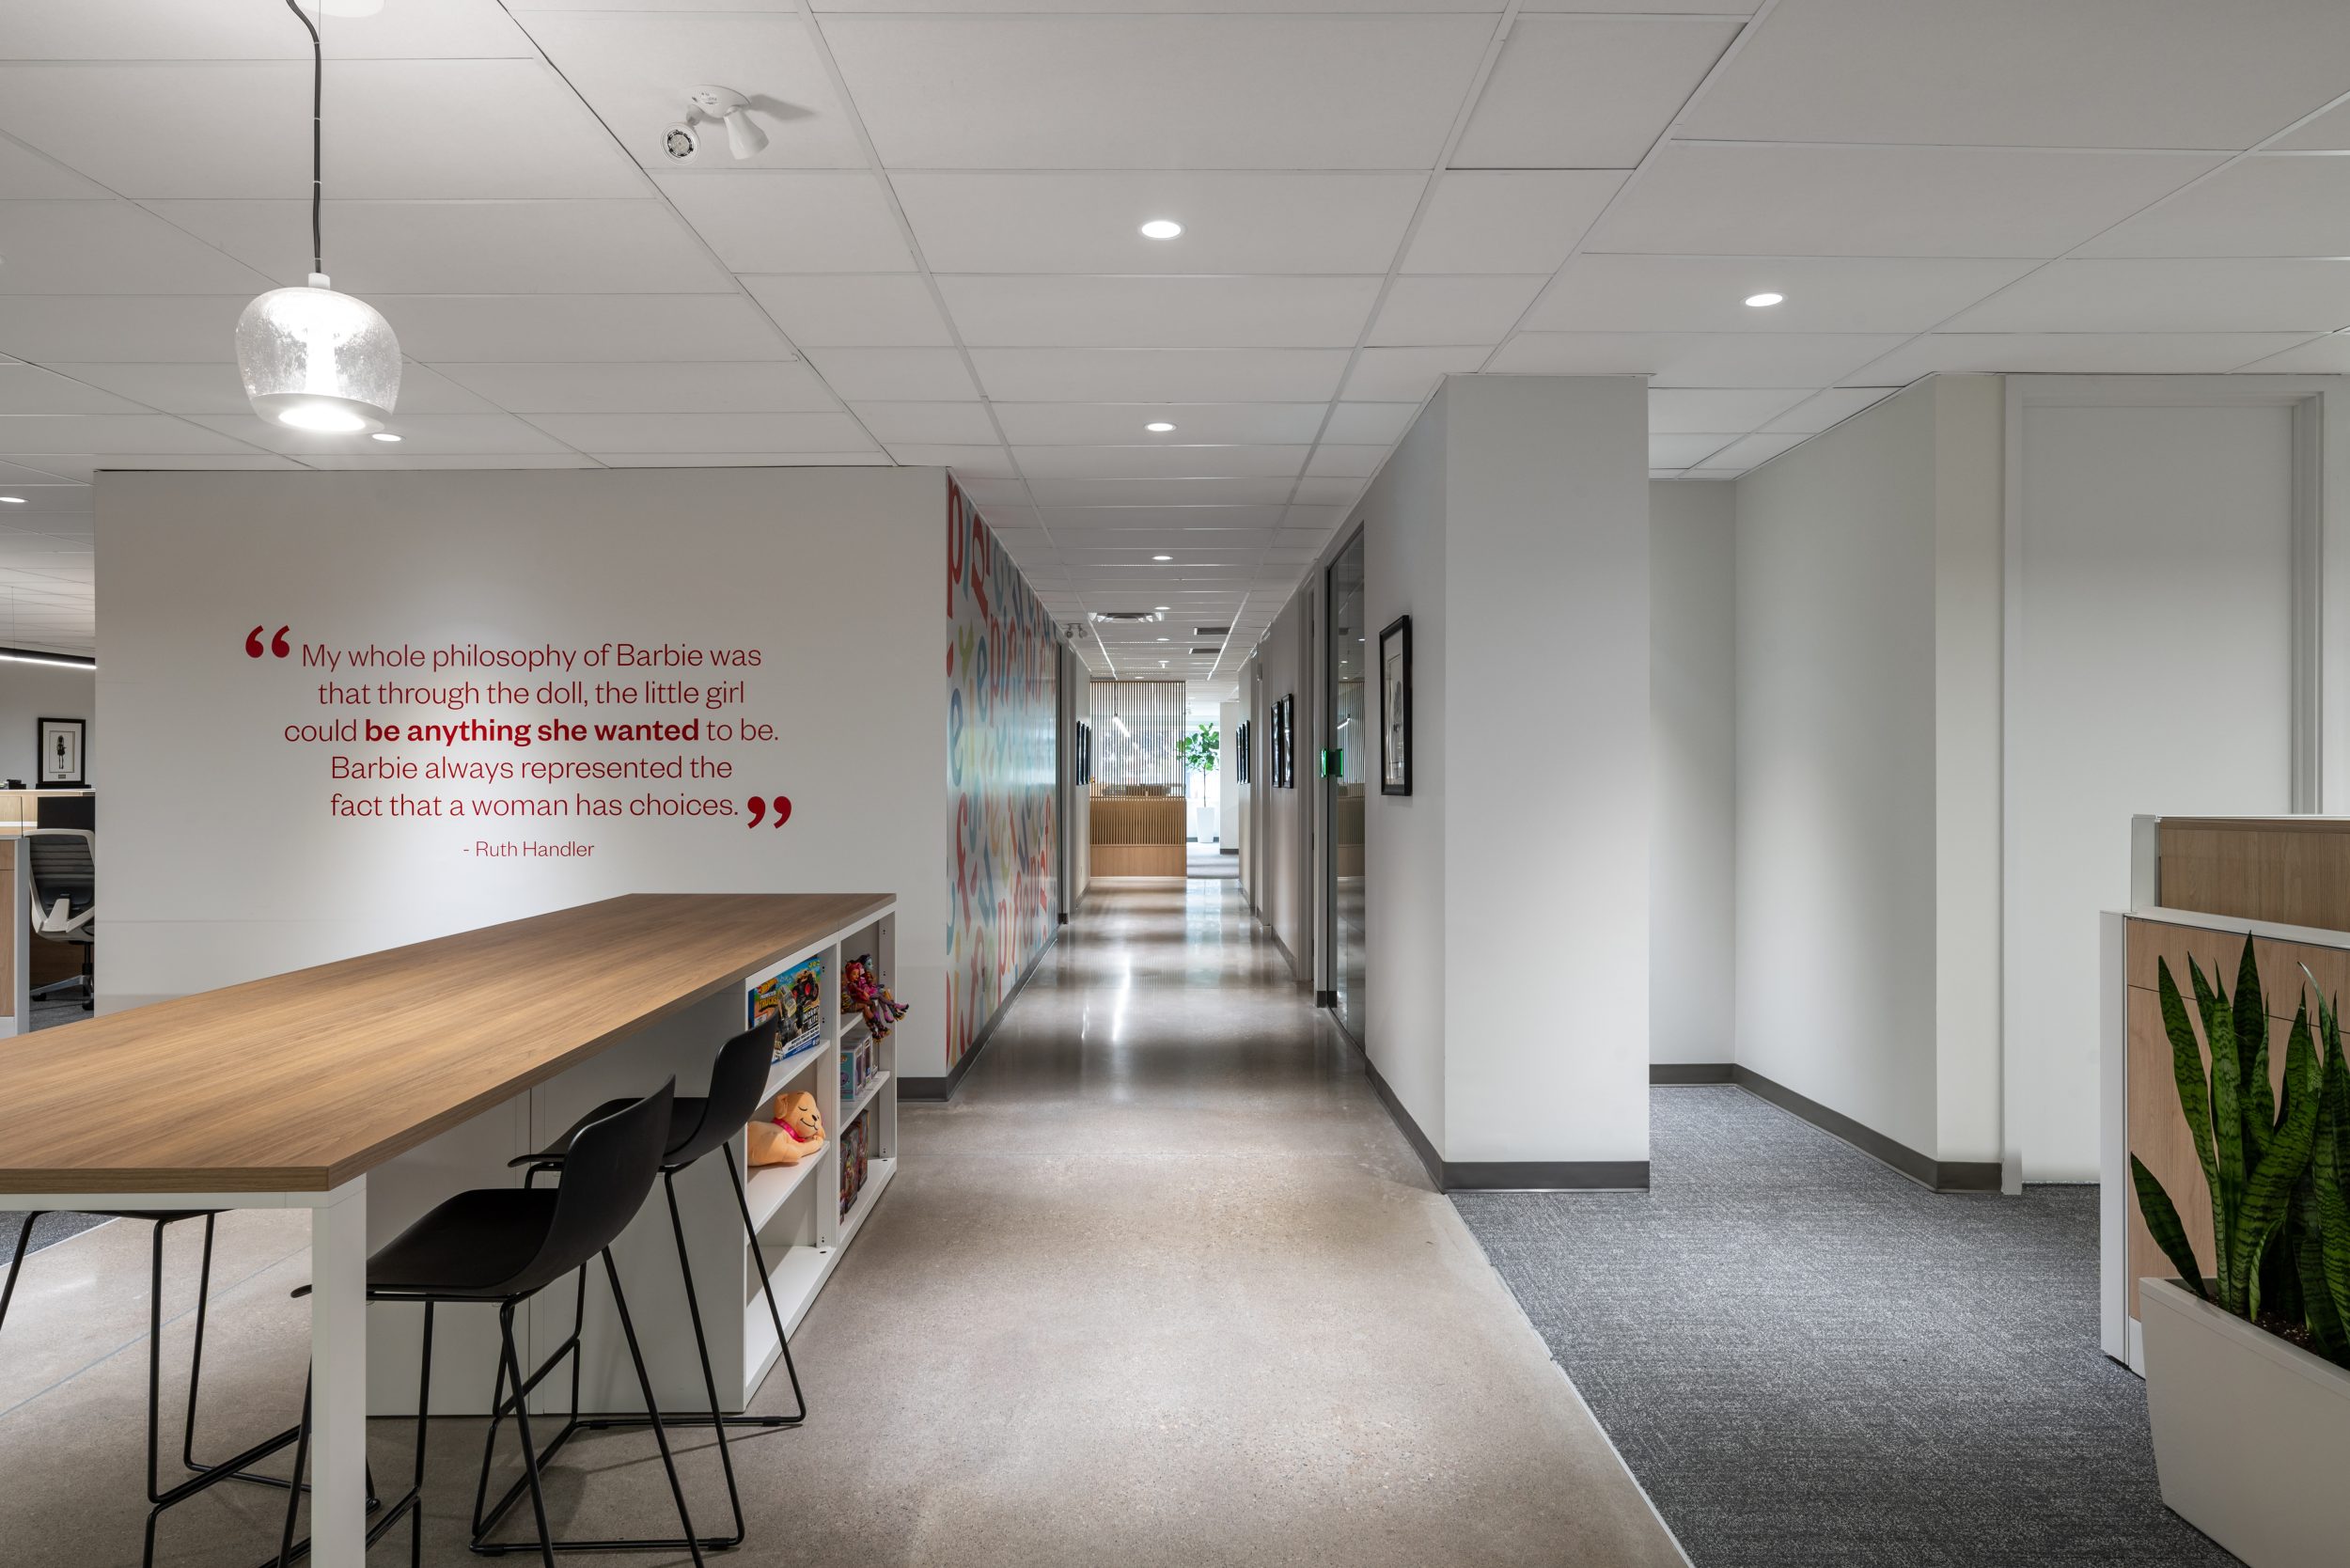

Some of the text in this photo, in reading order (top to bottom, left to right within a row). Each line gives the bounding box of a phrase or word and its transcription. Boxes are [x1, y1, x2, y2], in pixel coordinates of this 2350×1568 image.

[302, 642, 762, 673] My whole philosophy of Barbie was
[319, 678, 744, 711] that through the doll, the little girl
[285, 717, 779, 748] could be anything she wanted to be.
[331, 754, 733, 784] Barbie always represented the
[331, 792, 737, 818] fact that a woman has choices.
[476, 841, 518, 857] Ruth
[523, 842, 595, 857] Handler
